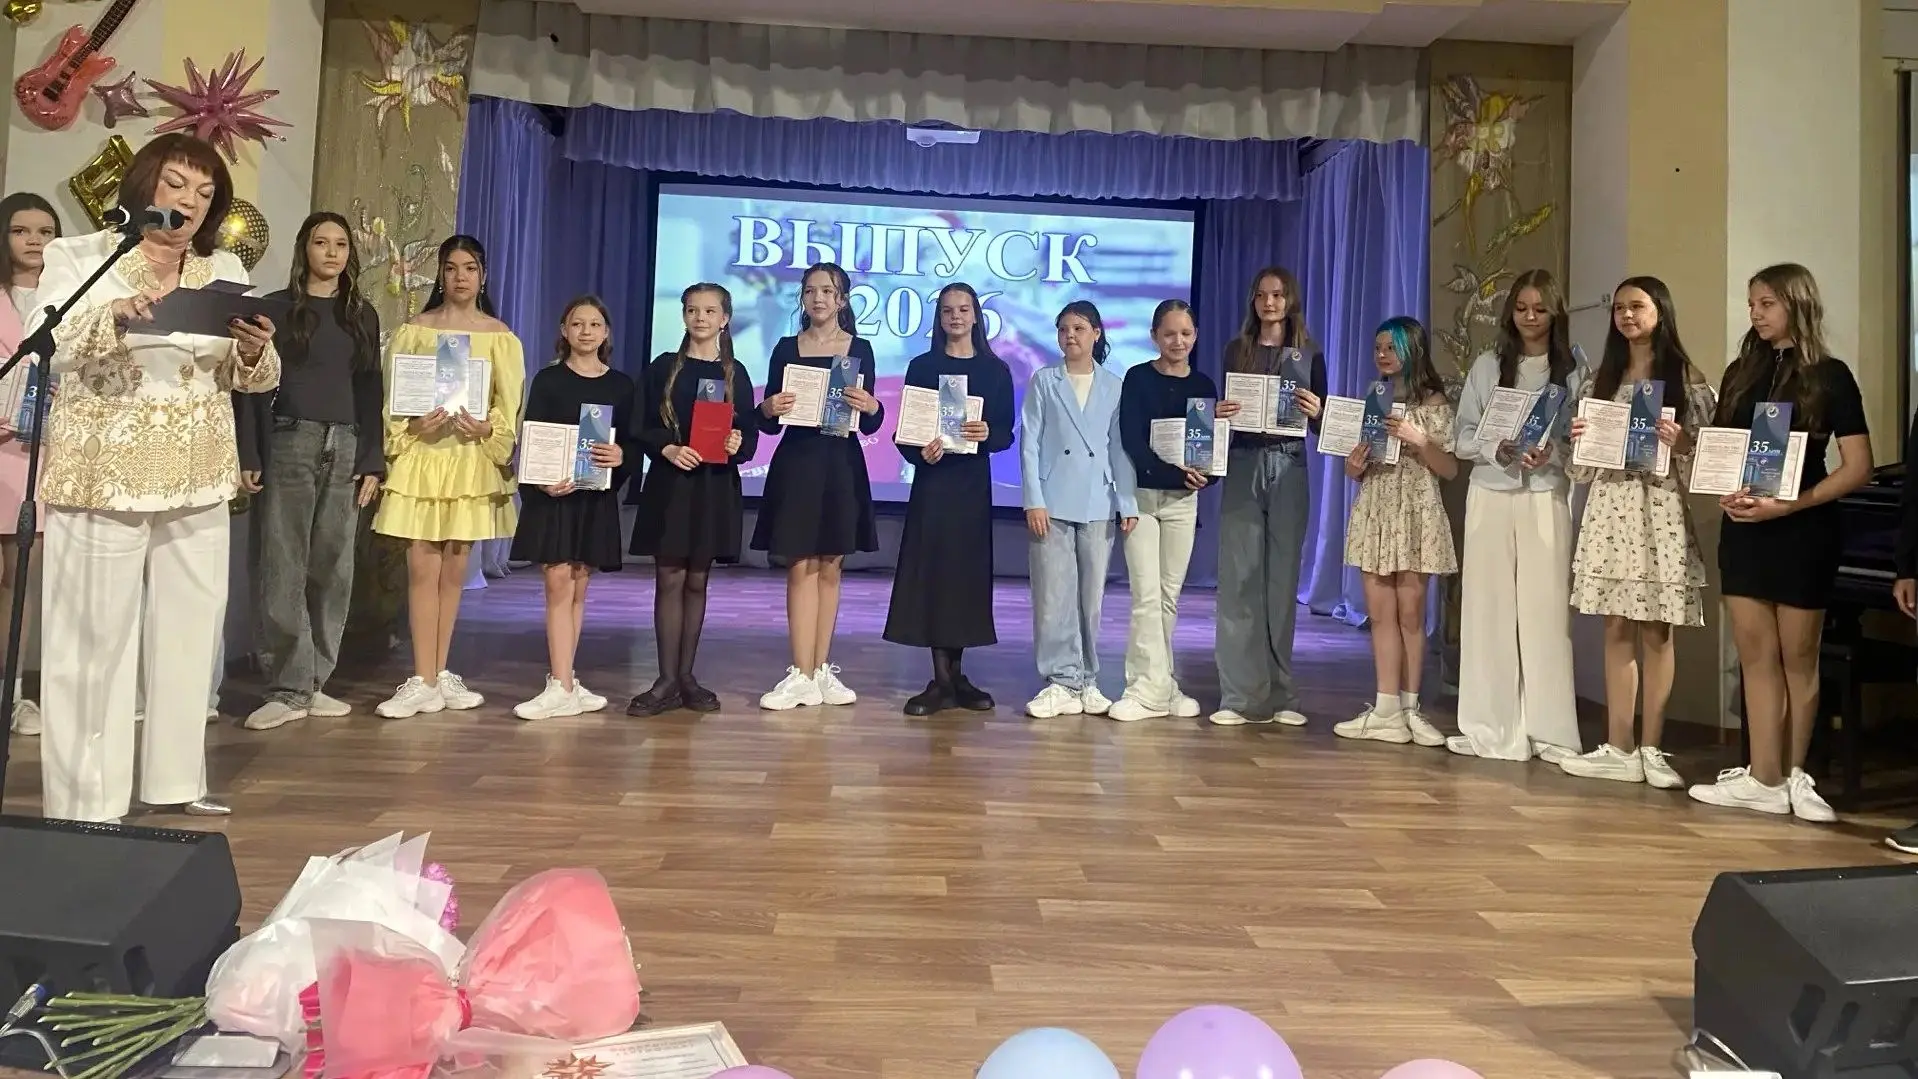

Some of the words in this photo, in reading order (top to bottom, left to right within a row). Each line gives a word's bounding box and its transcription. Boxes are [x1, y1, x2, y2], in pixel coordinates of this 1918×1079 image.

[732, 214, 1099, 285] ВЫПУСК
[848, 285, 1003, 341] 206
[1281, 379, 1297, 391] 35
[828, 387, 843, 399] 35
[940, 406, 954, 417] 35
[1364, 414, 1379, 426] 35
[1526, 414, 1540, 427] 35
[1631, 417, 1647, 430] 35
[1187, 428, 1201, 439] 35
[579, 438, 595, 450] 35
[1750, 440, 1770, 454] 35
